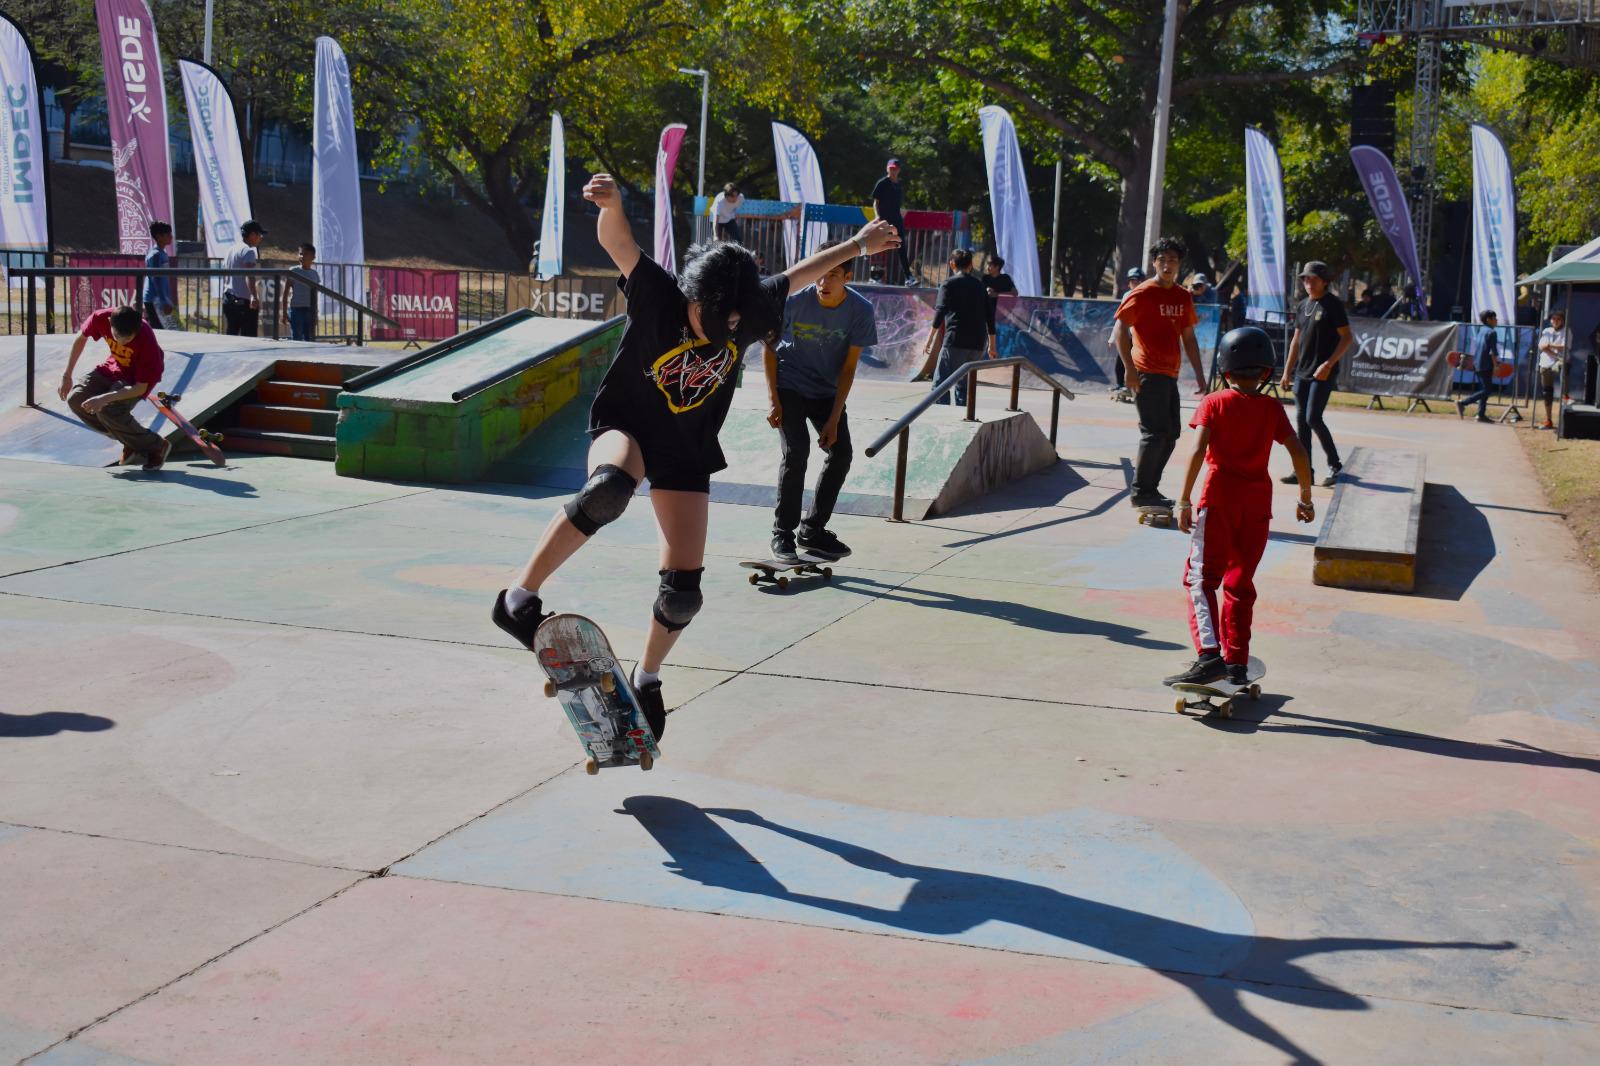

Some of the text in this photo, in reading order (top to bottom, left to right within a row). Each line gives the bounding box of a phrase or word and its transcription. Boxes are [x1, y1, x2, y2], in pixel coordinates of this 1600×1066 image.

[391, 294, 453, 312] SINALOA
[548, 291, 605, 313] ISDE
[1374, 336, 1429, 360] ISDE
